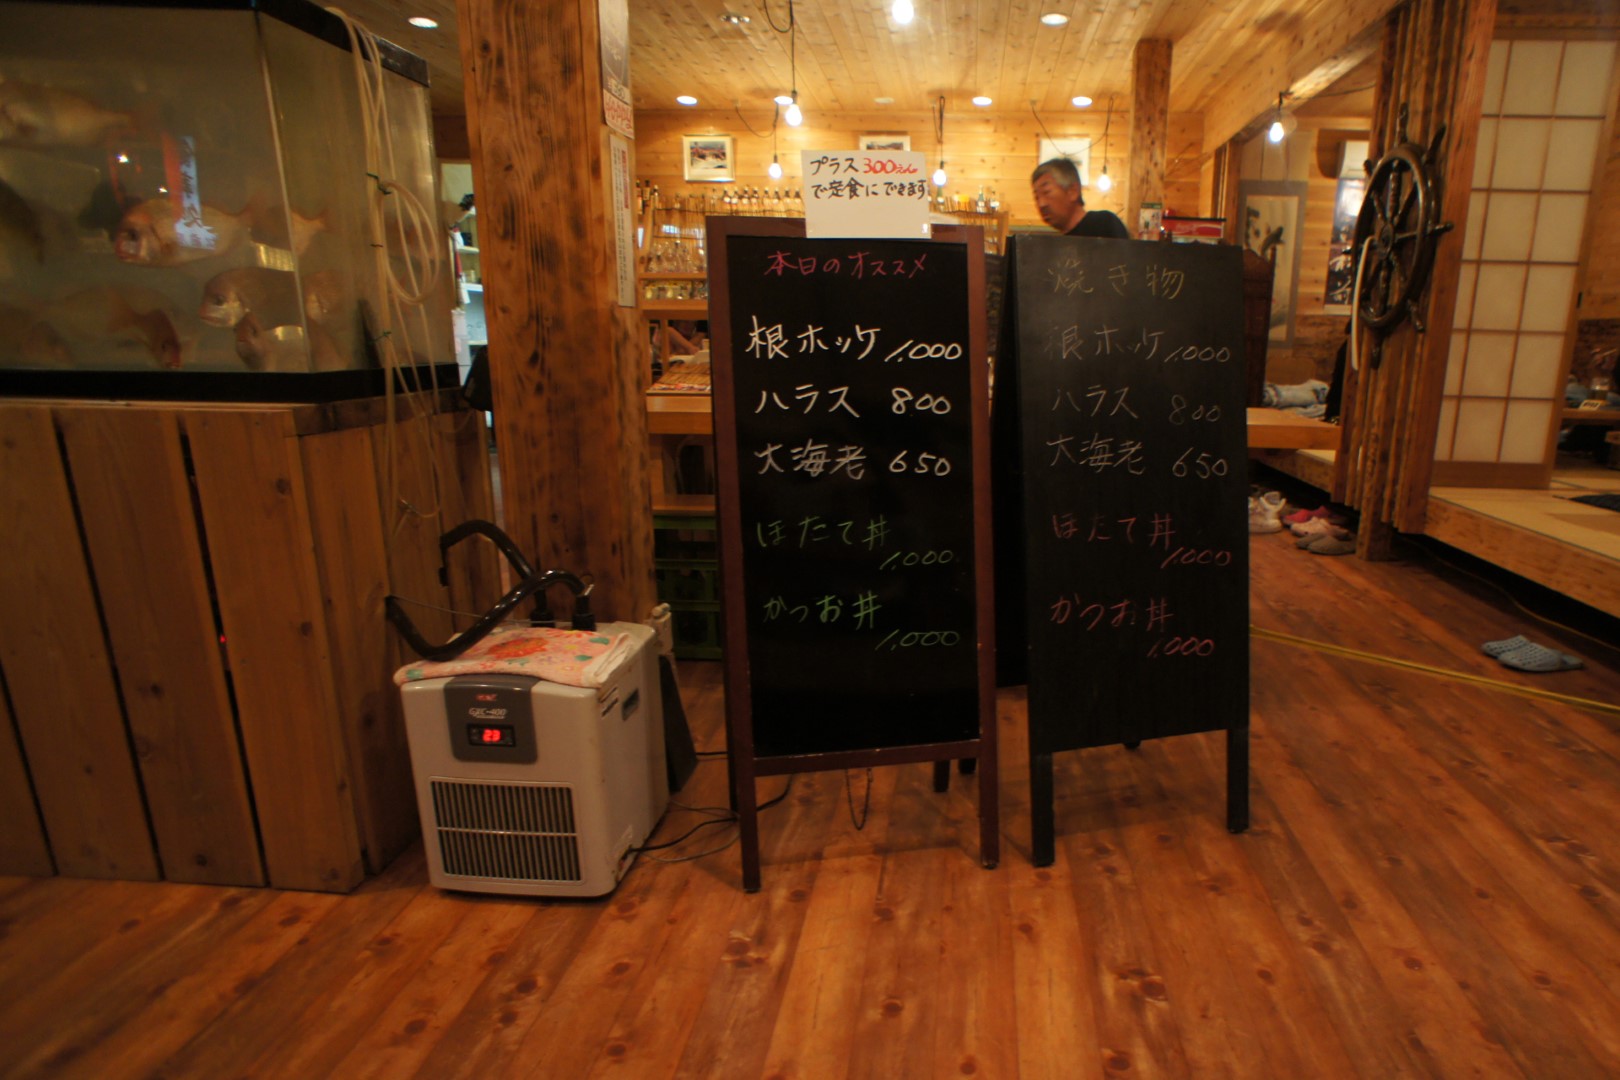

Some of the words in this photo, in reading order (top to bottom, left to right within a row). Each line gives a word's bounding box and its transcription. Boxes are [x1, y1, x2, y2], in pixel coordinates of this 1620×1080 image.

[811, 177, 926, 200] で定食にできます
[764, 251, 927, 279] 本日のオススメ
[1048, 258, 1184, 299] 焼き物
[745, 315, 881, 359] 根ホッケ
[755, 384, 860, 417] ハラス
[891, 387, 951, 414] 800
[1052, 385, 1138, 419] ハラス
[1169, 394, 1221, 425] 800
[754, 439, 867, 480] 大海老
[889, 450, 951, 476] 650
[1046, 432, 1146, 475] 大海老
[1172, 447, 1228, 479] 650
